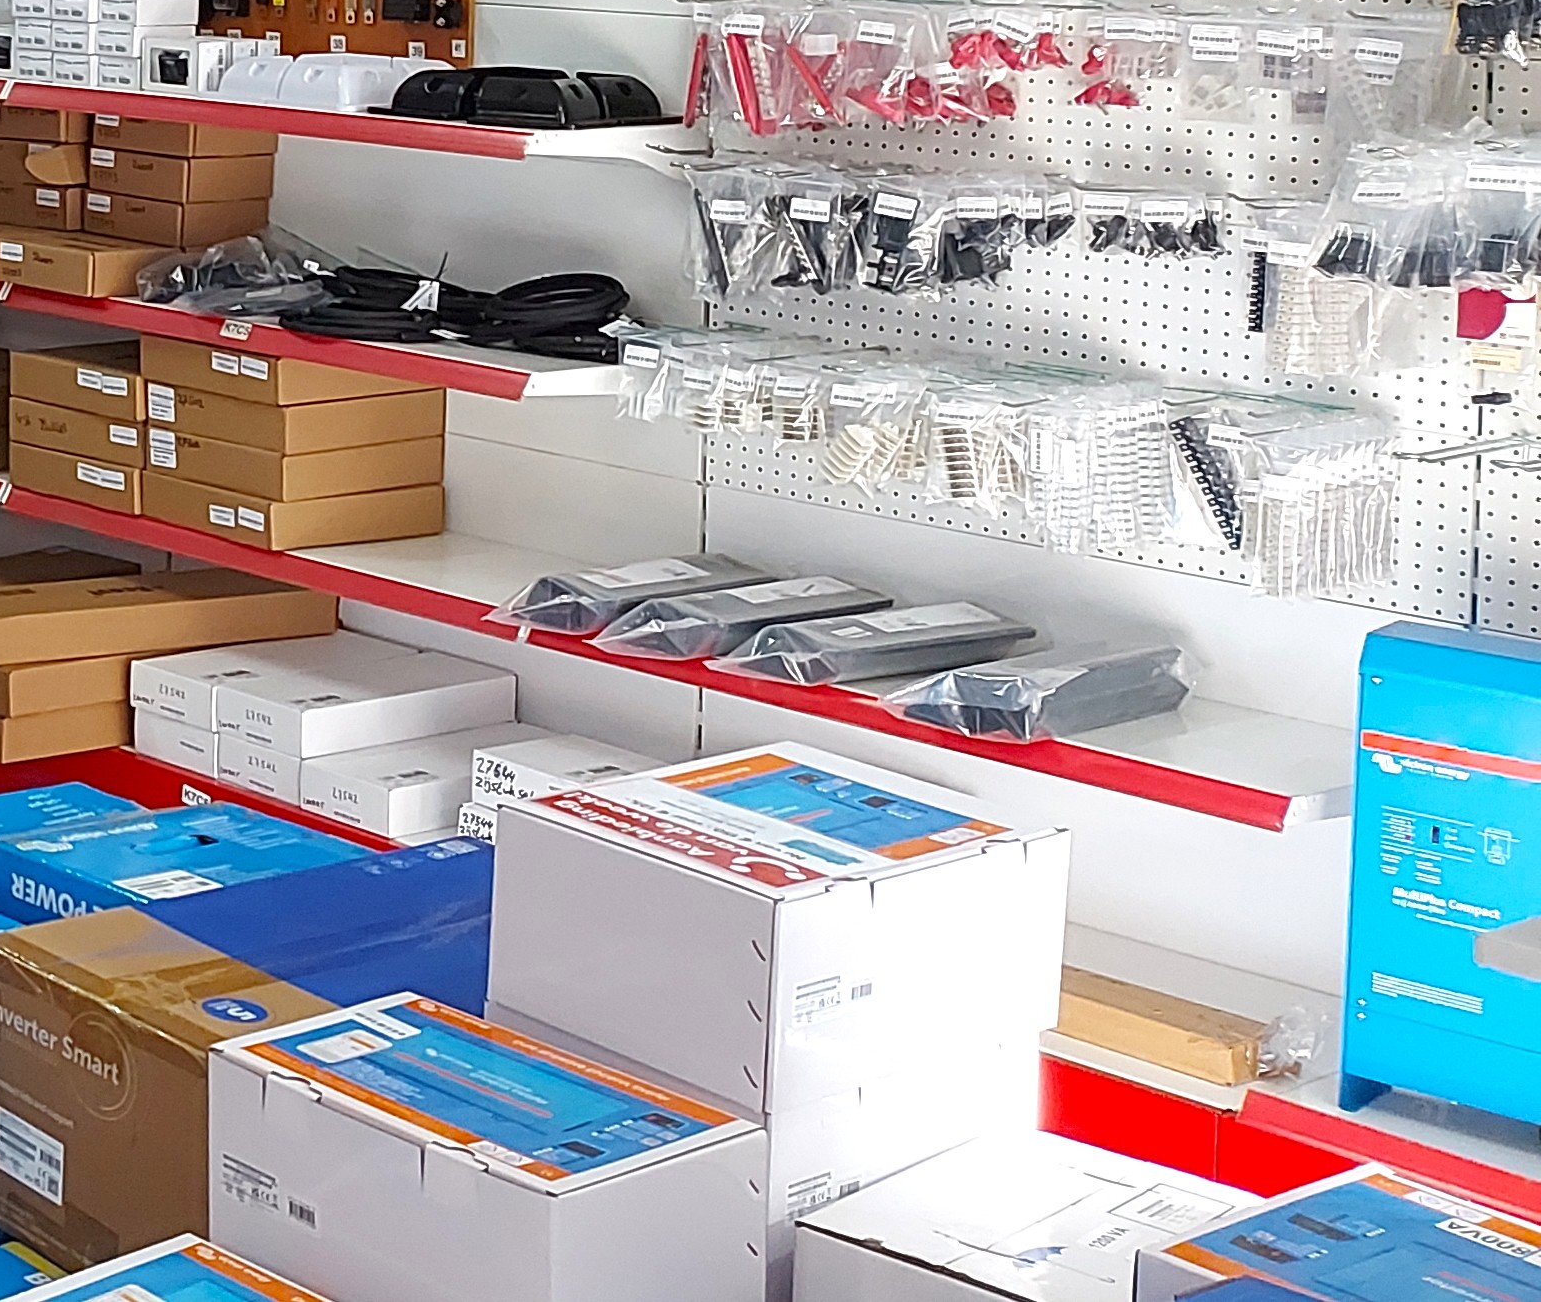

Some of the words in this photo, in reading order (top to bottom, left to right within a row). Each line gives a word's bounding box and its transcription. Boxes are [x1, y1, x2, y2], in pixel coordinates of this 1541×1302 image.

[563, 792, 648, 823] week!
[553, 800, 715, 857] Aanbieding
[655, 821, 693, 835] de
[696, 835, 749, 855] van
[1448, 900, 1500, 920] Compact
[62, 1036, 119, 1086] Smart
[1448, 1220, 1530, 1257] 800VA
